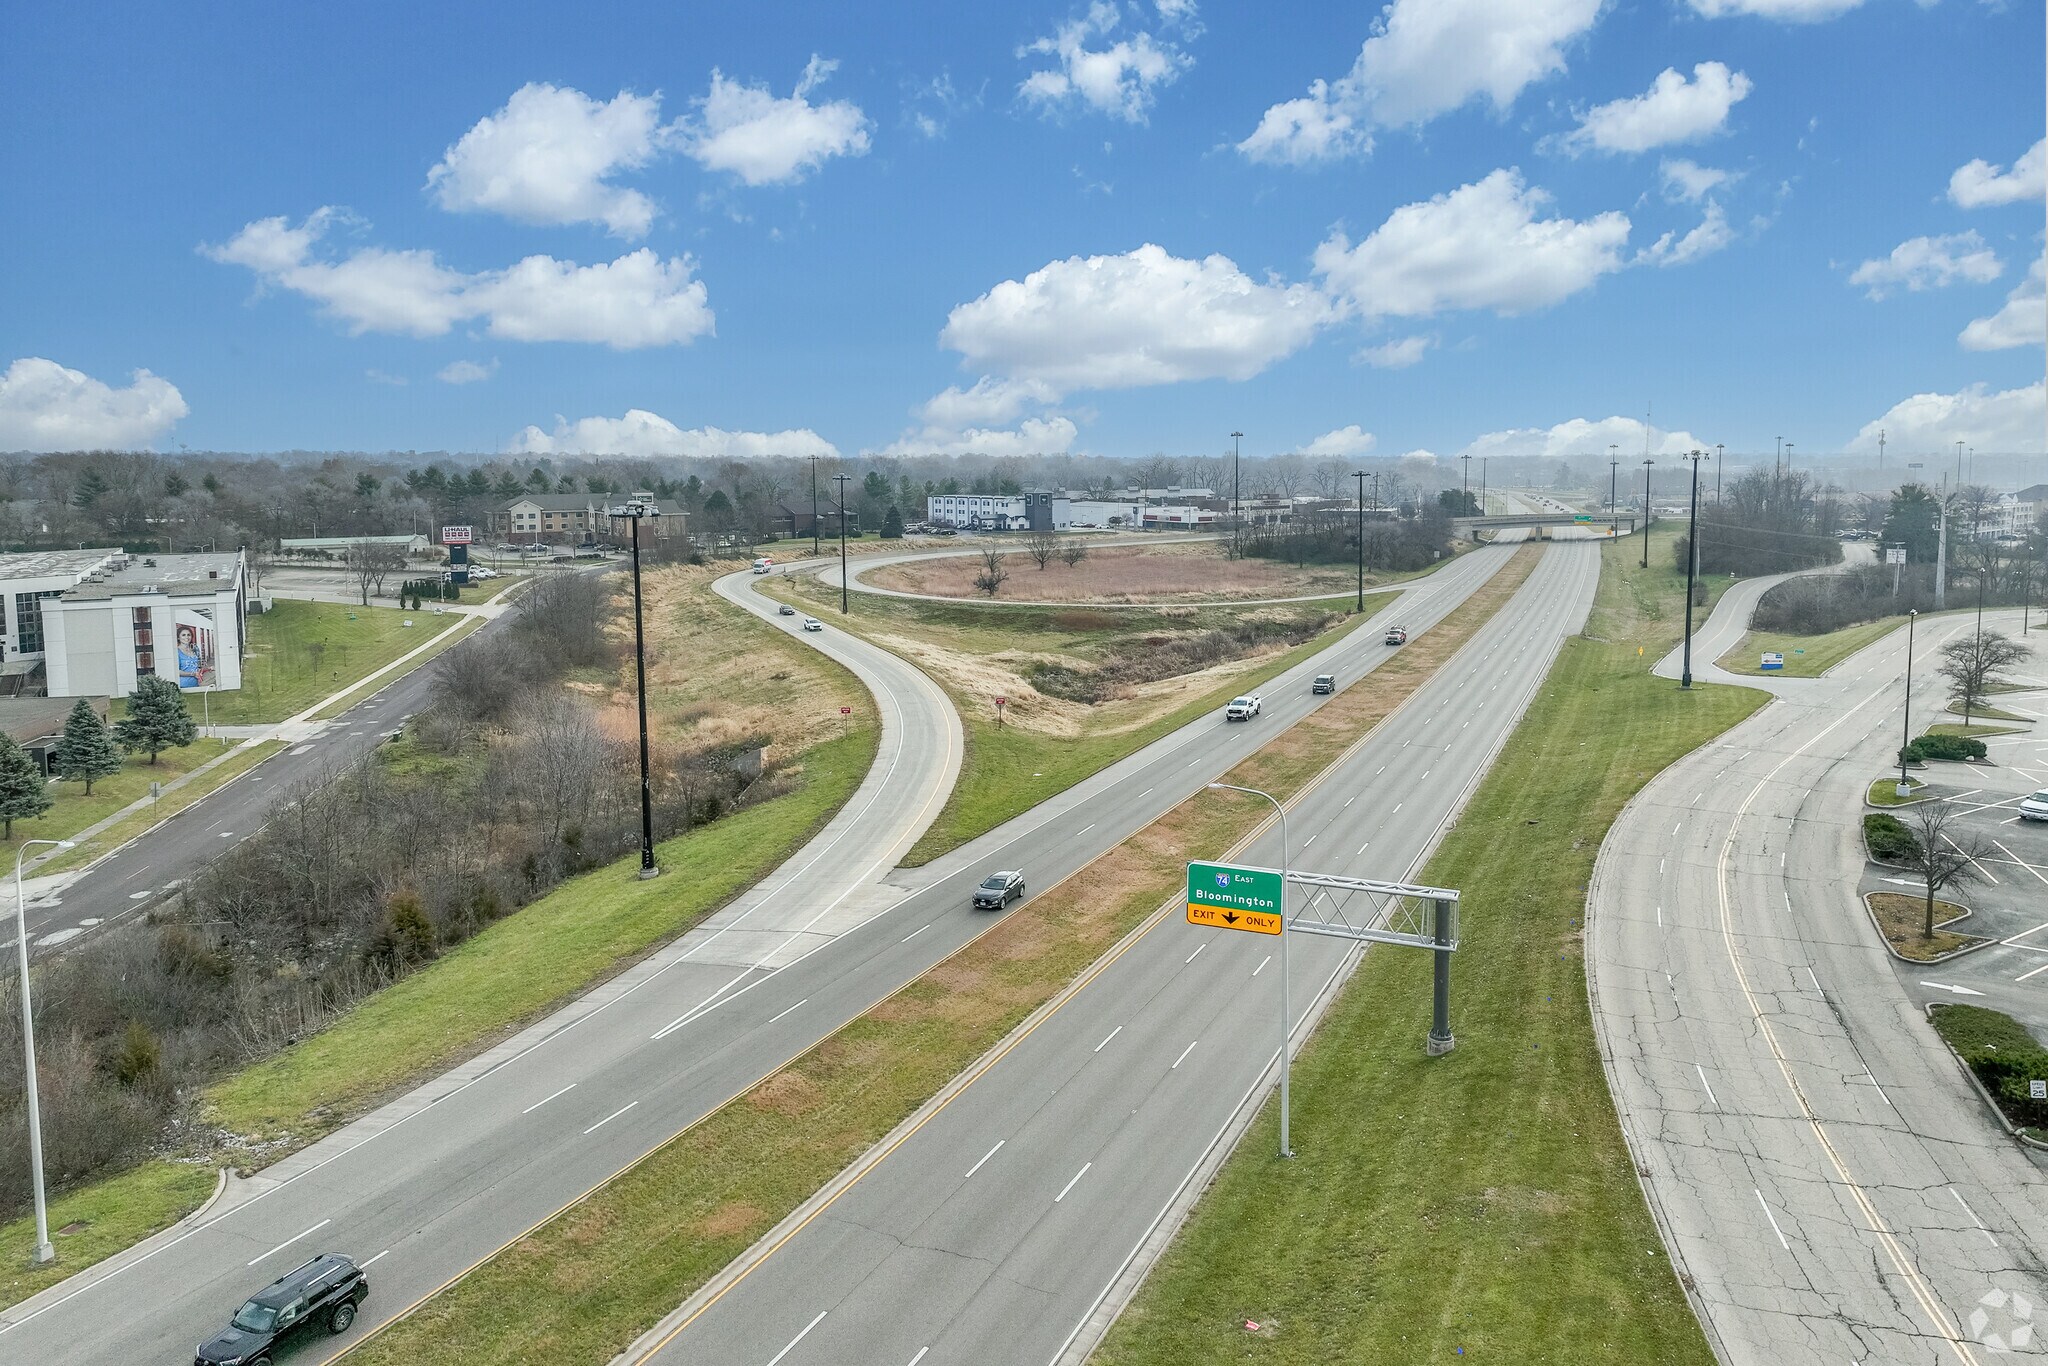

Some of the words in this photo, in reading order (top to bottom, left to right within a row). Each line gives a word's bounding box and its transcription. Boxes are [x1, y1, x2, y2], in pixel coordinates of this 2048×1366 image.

[1218, 876, 1228, 885] 74
[1196, 889, 1273, 907] Bloomington
[1194, 909, 1215, 919] EXIT
[1246, 917, 1275, 927] ONLY
